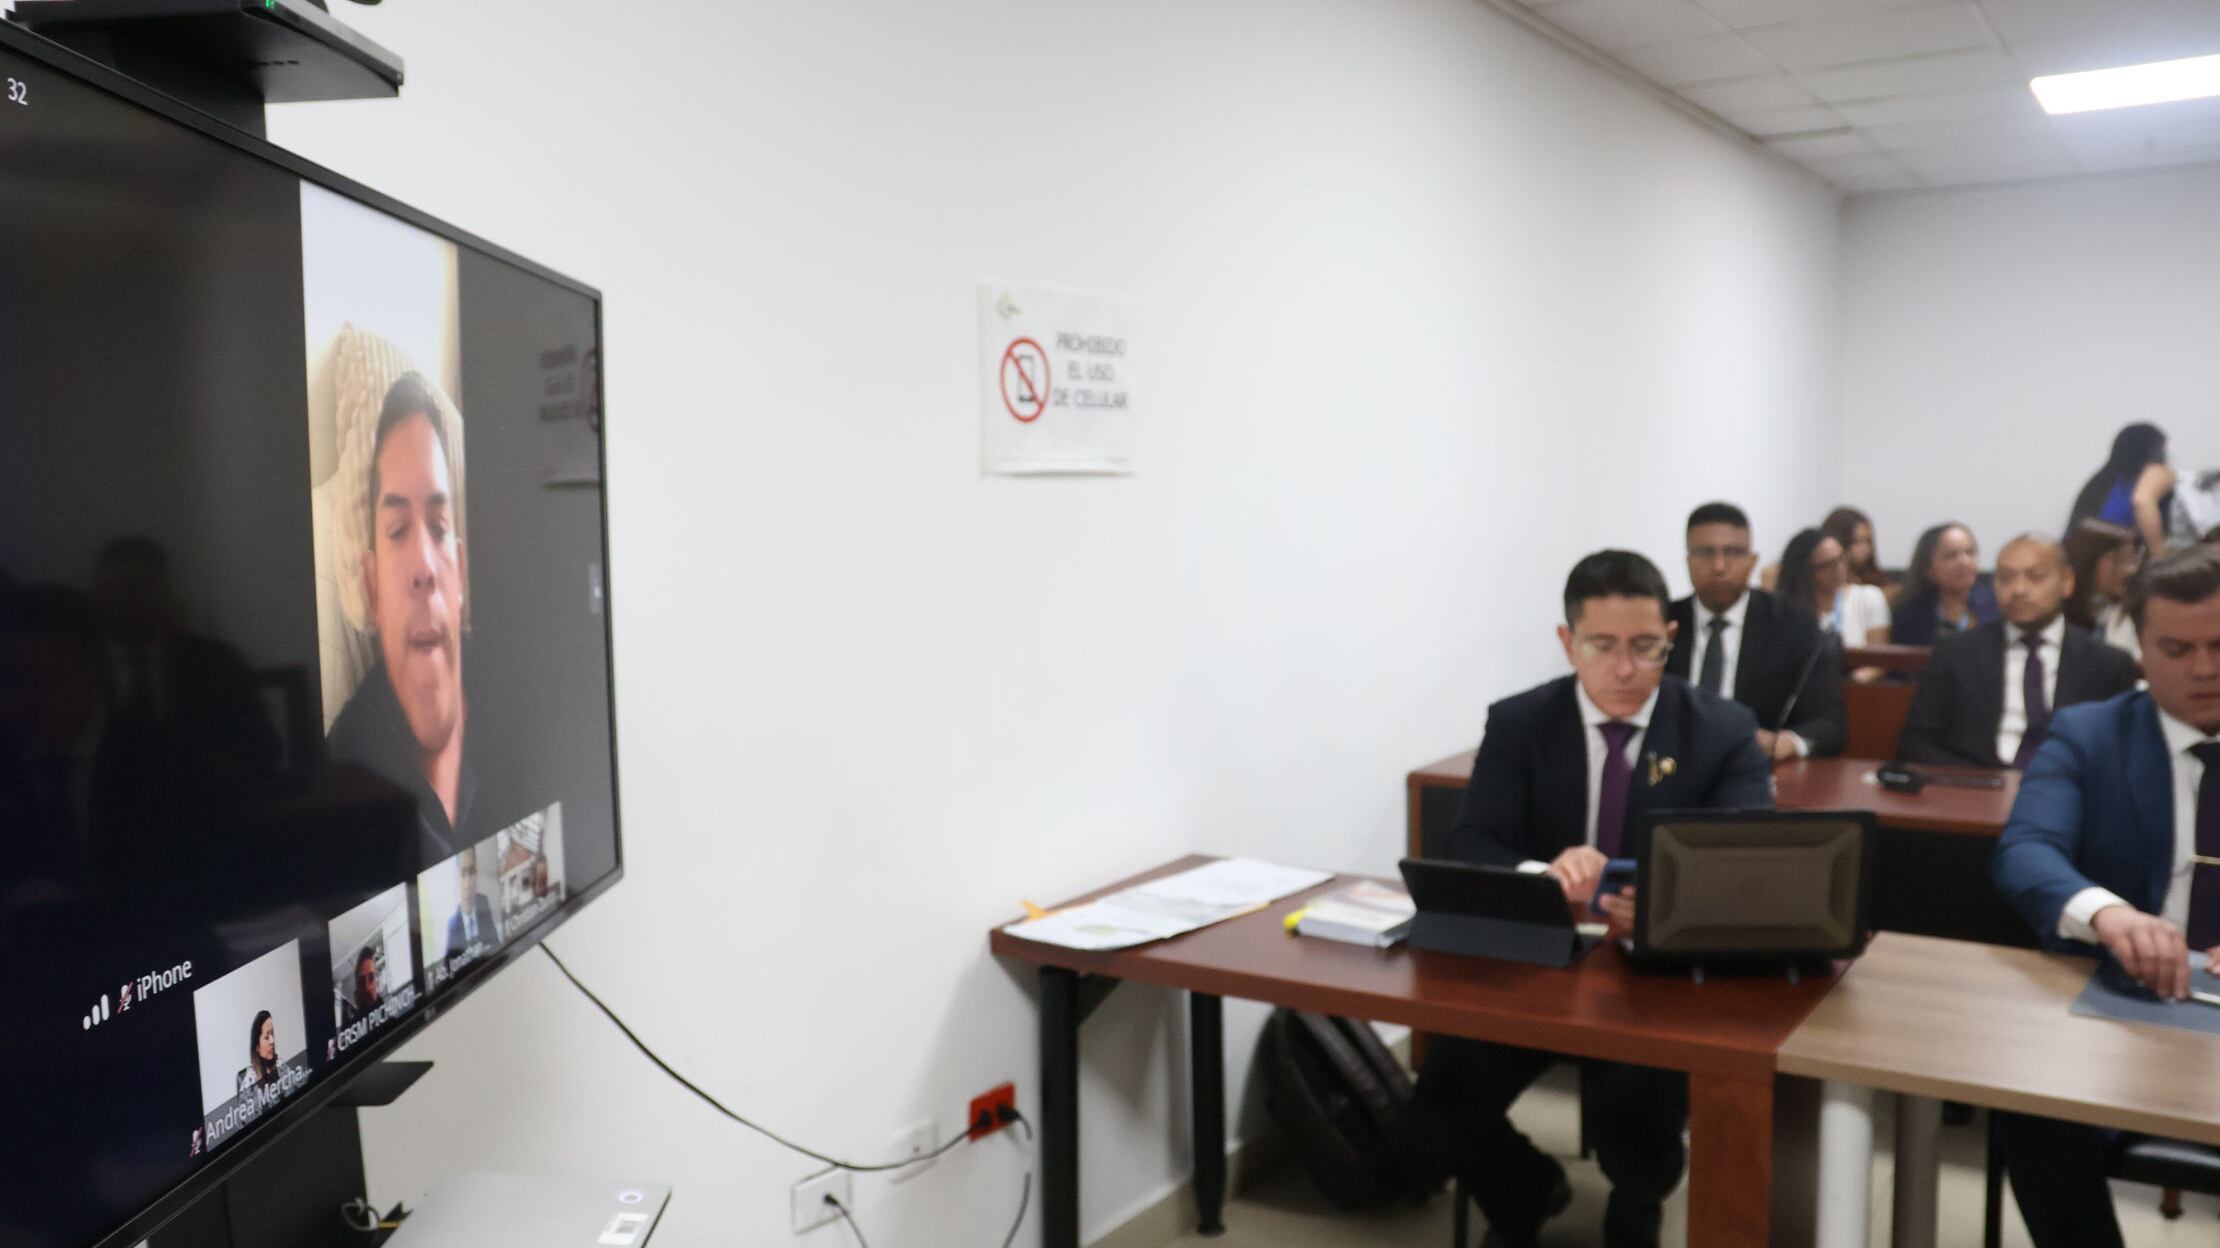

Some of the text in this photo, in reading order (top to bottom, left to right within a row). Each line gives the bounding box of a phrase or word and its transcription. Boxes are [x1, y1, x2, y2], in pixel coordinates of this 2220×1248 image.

[7, 77, 28, 105] 32
[136, 960, 193, 1002] iPhone
[205, 1096, 254, 1147] Andrea
